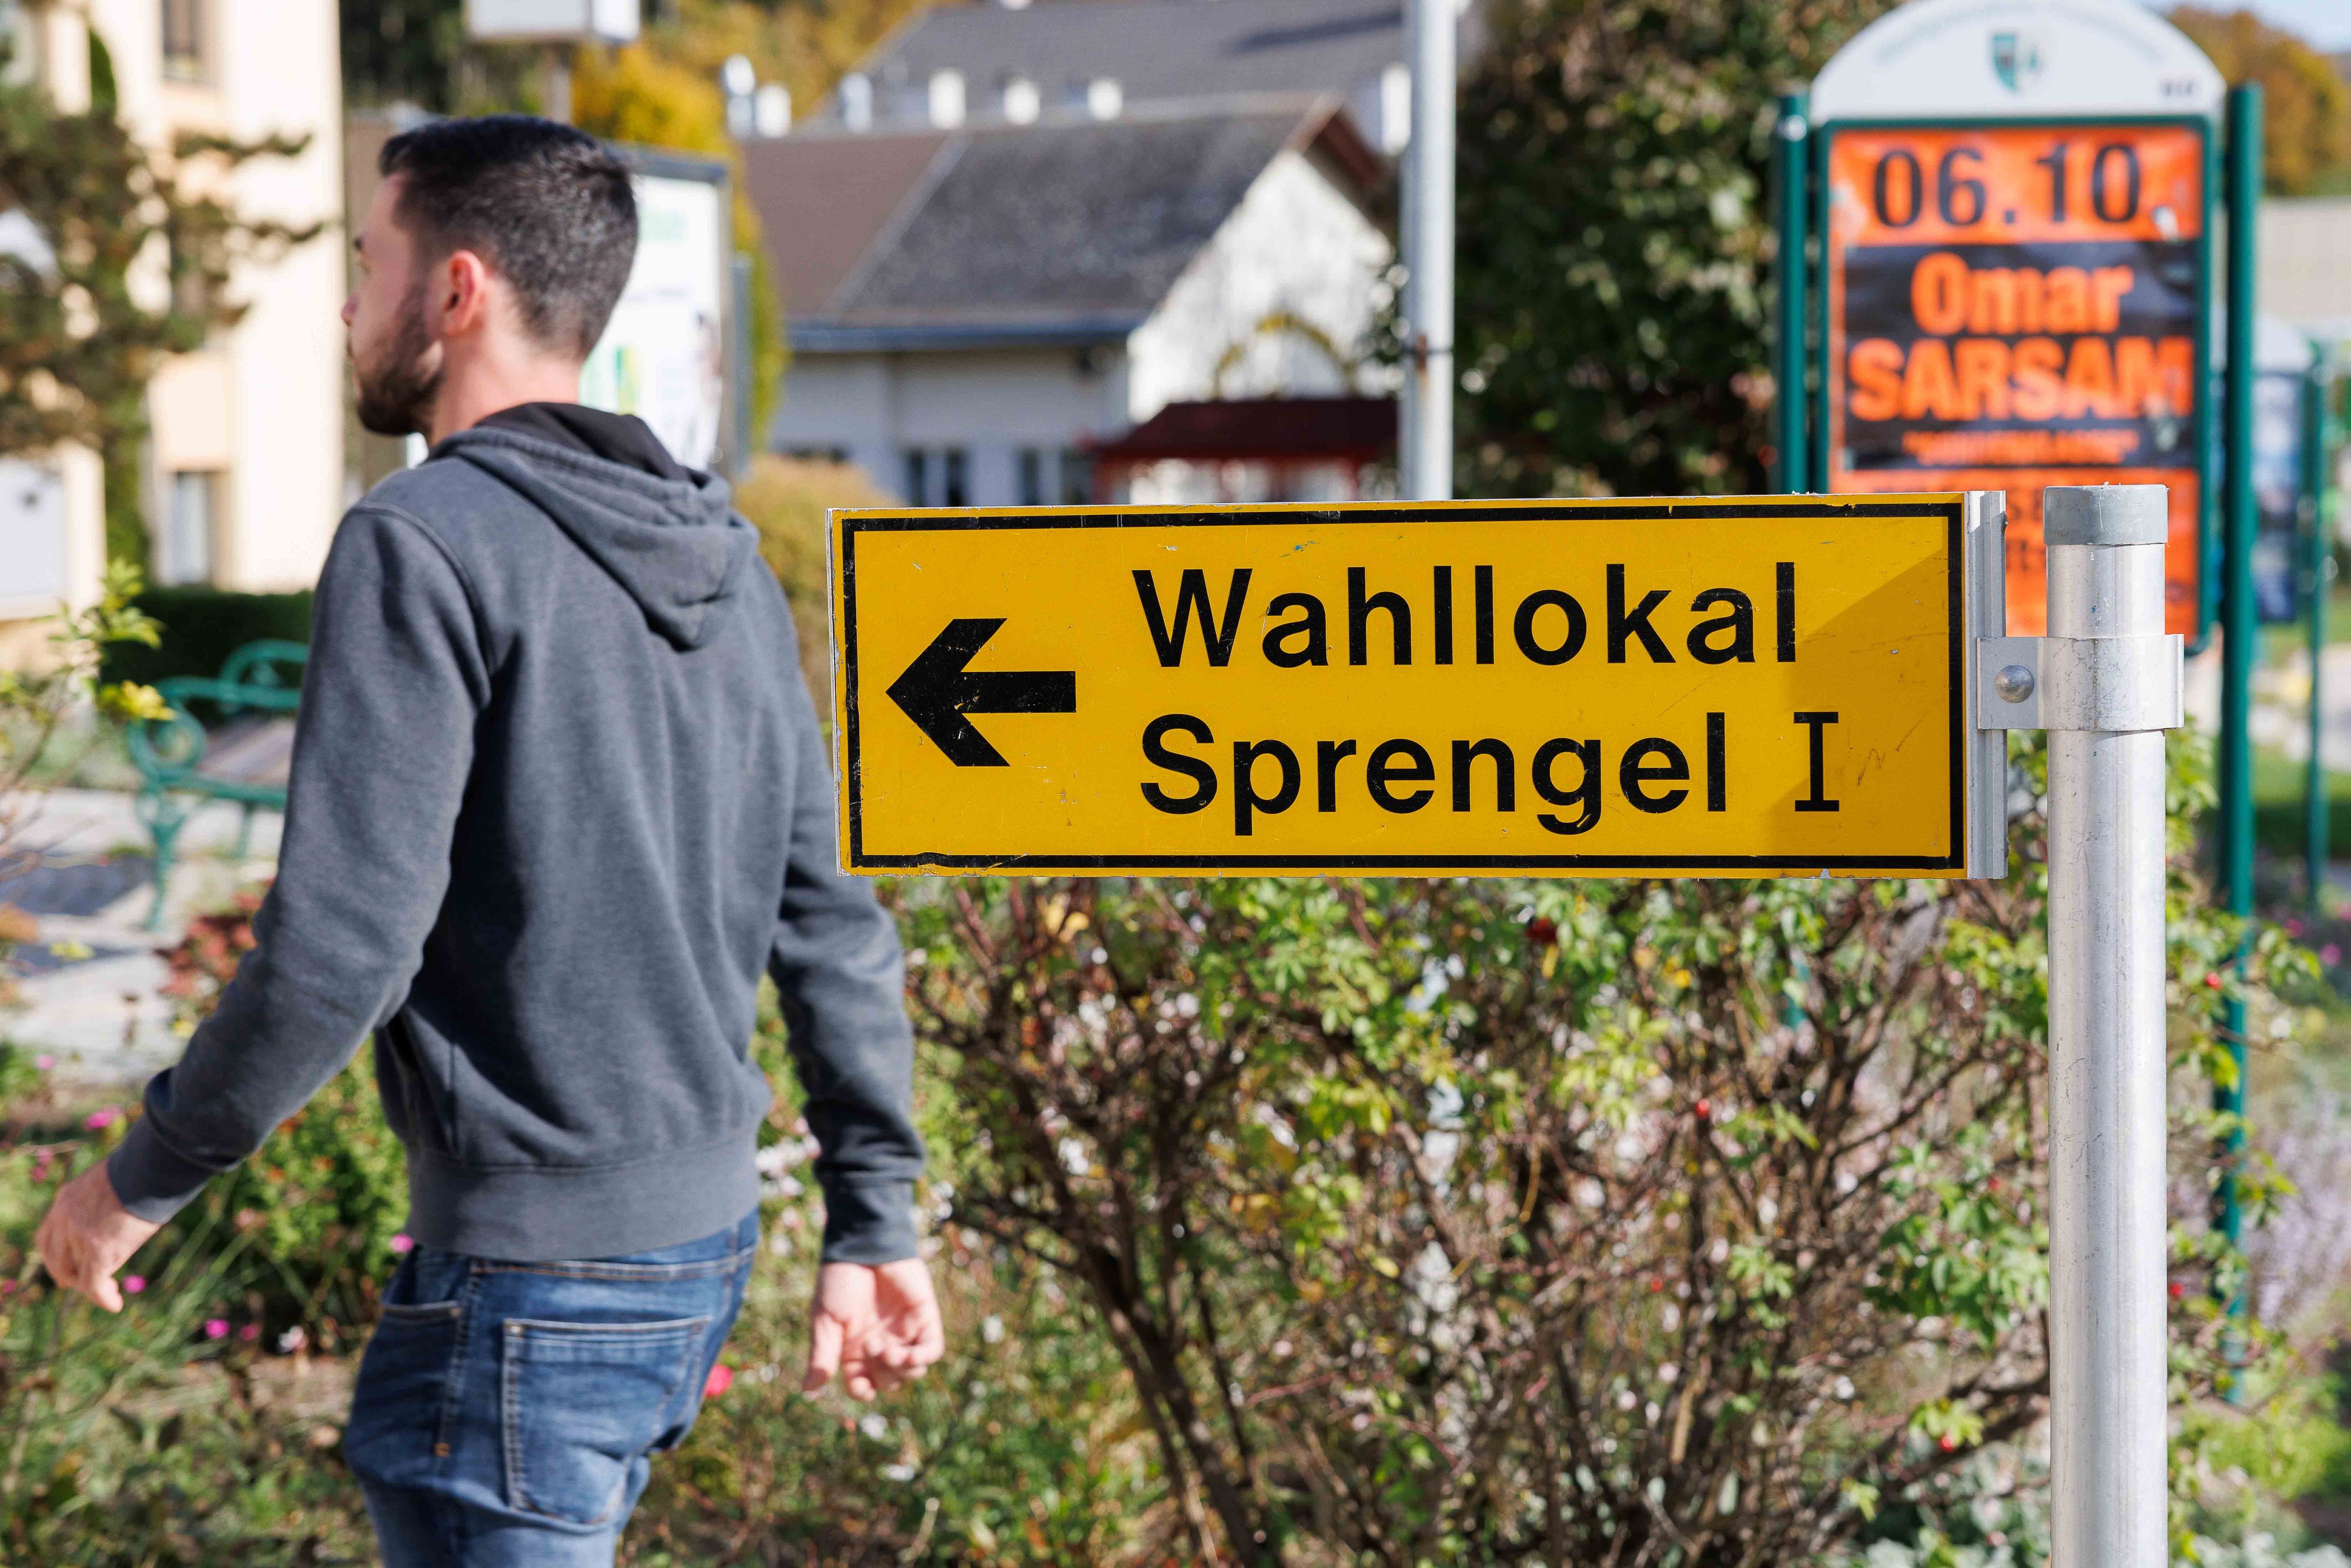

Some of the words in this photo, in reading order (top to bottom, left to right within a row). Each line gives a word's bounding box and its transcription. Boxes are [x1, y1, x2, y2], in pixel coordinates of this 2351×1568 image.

[1911, 252, 2134, 336] Omar
[1848, 336, 2193, 421] SARSAM
[1132, 562, 1796, 668] Wahllokal
[1140, 712, 1726, 836] Sprengel
[1794, 711, 1840, 812] I
